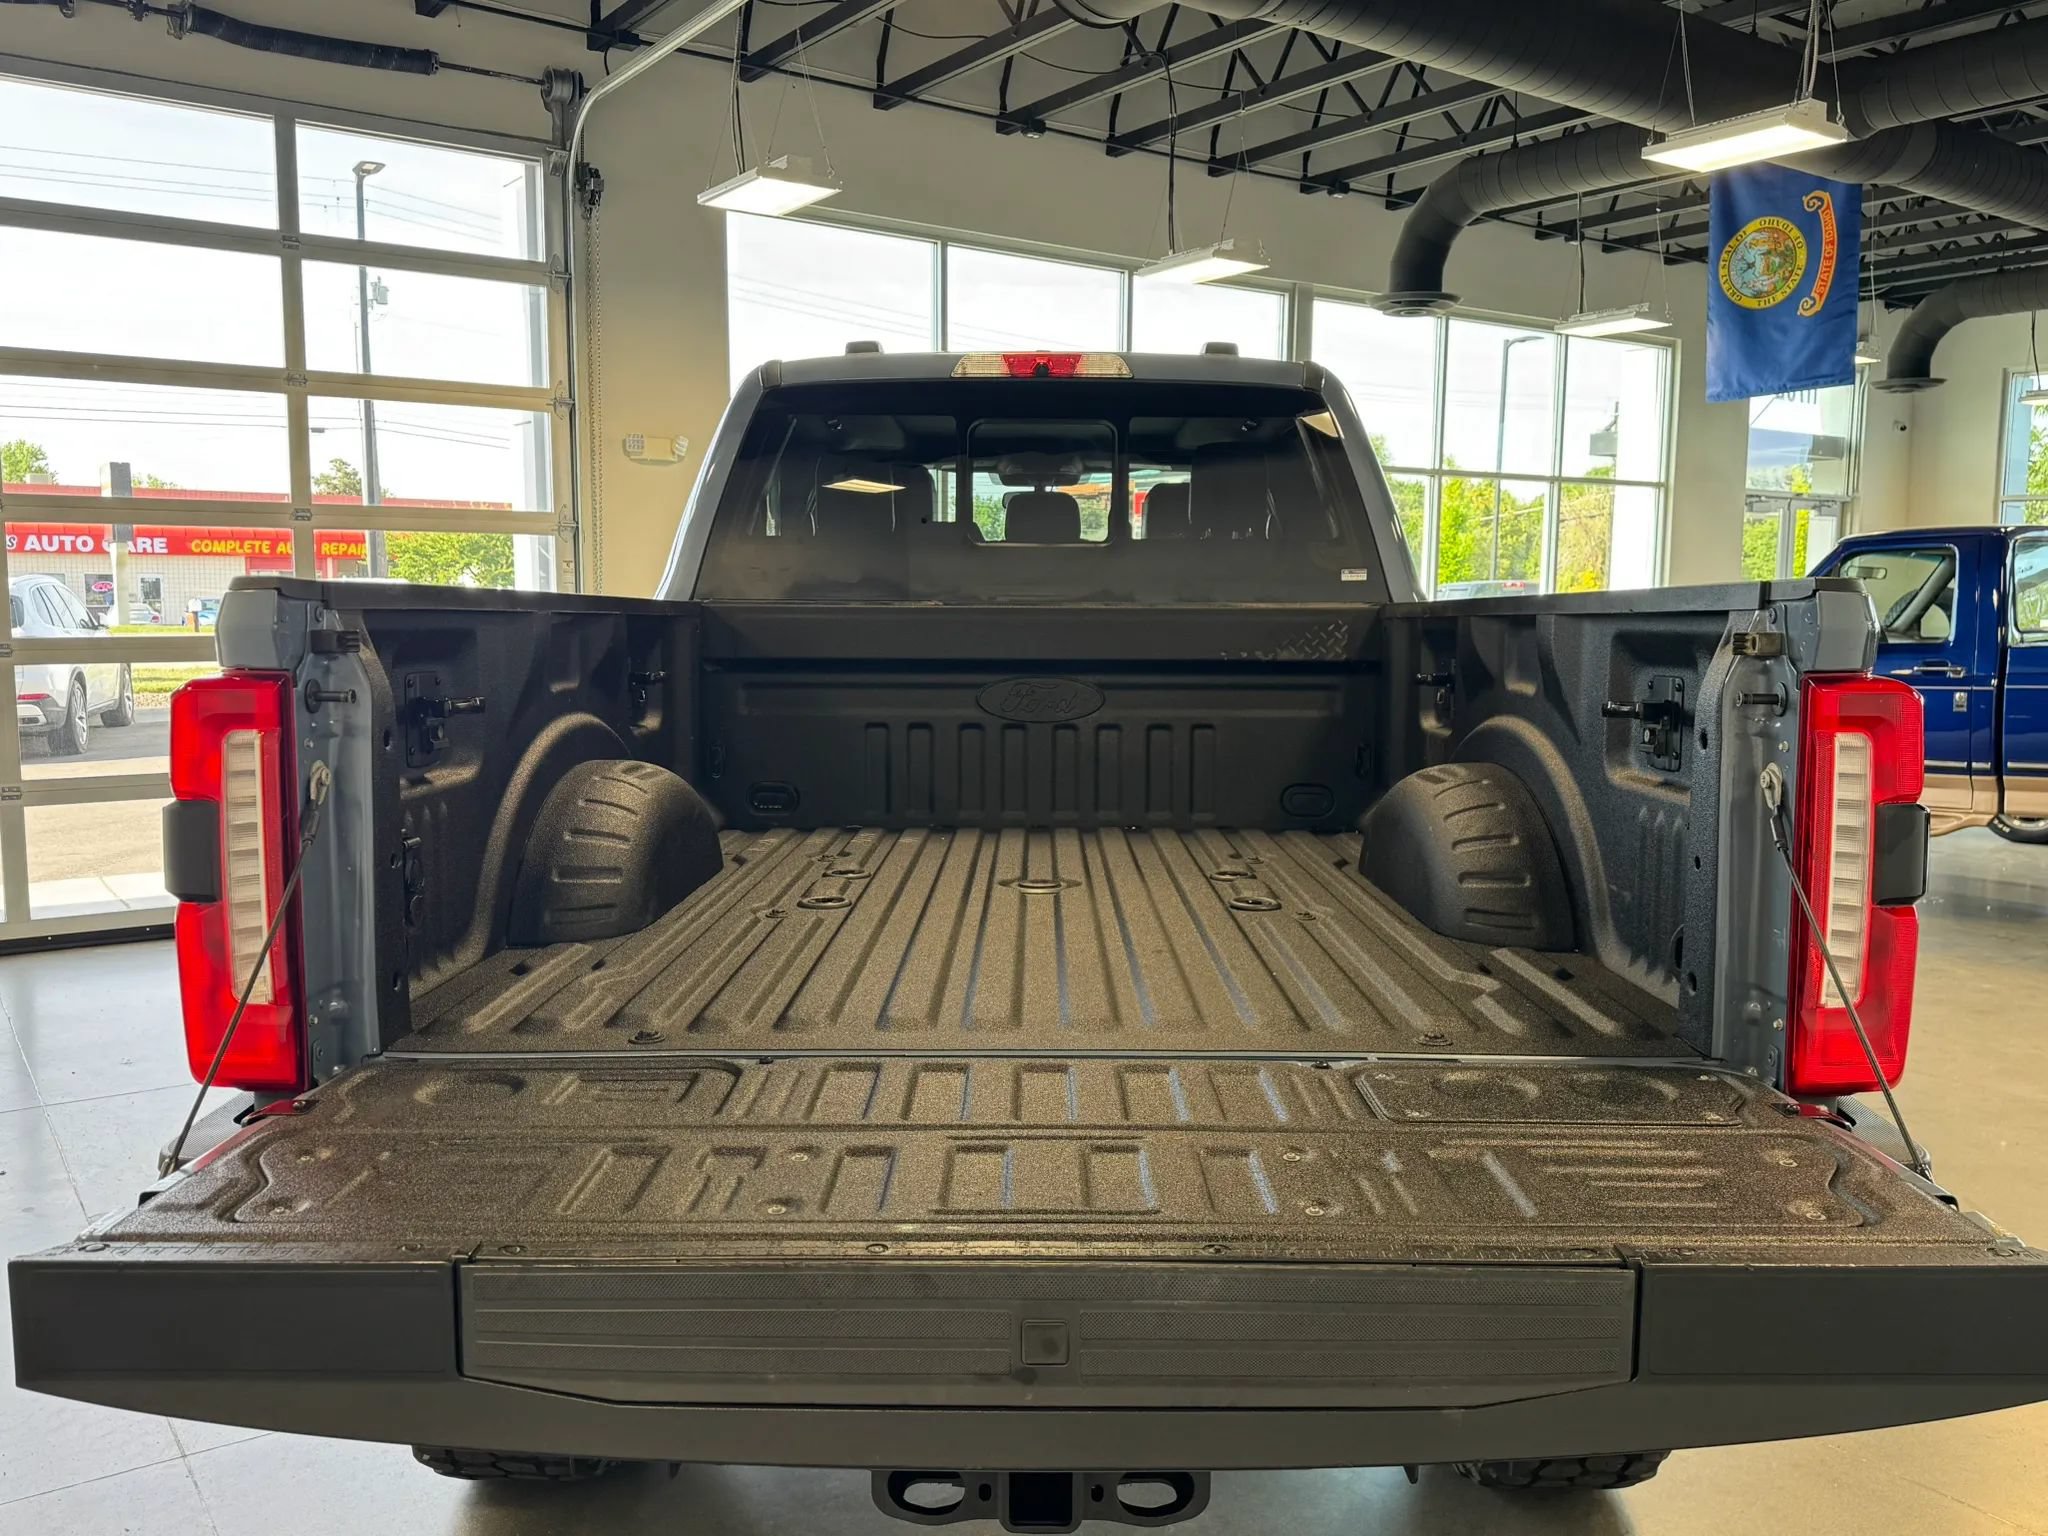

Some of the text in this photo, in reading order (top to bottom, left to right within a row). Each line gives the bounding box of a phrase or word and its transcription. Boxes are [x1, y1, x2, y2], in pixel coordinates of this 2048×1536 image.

[1815, 260, 1833, 294] STATE
[24, 534, 95, 553] AUTO
[191, 539, 271, 554] COMPLETE
[1001, 682, 1080, 714] Ford
